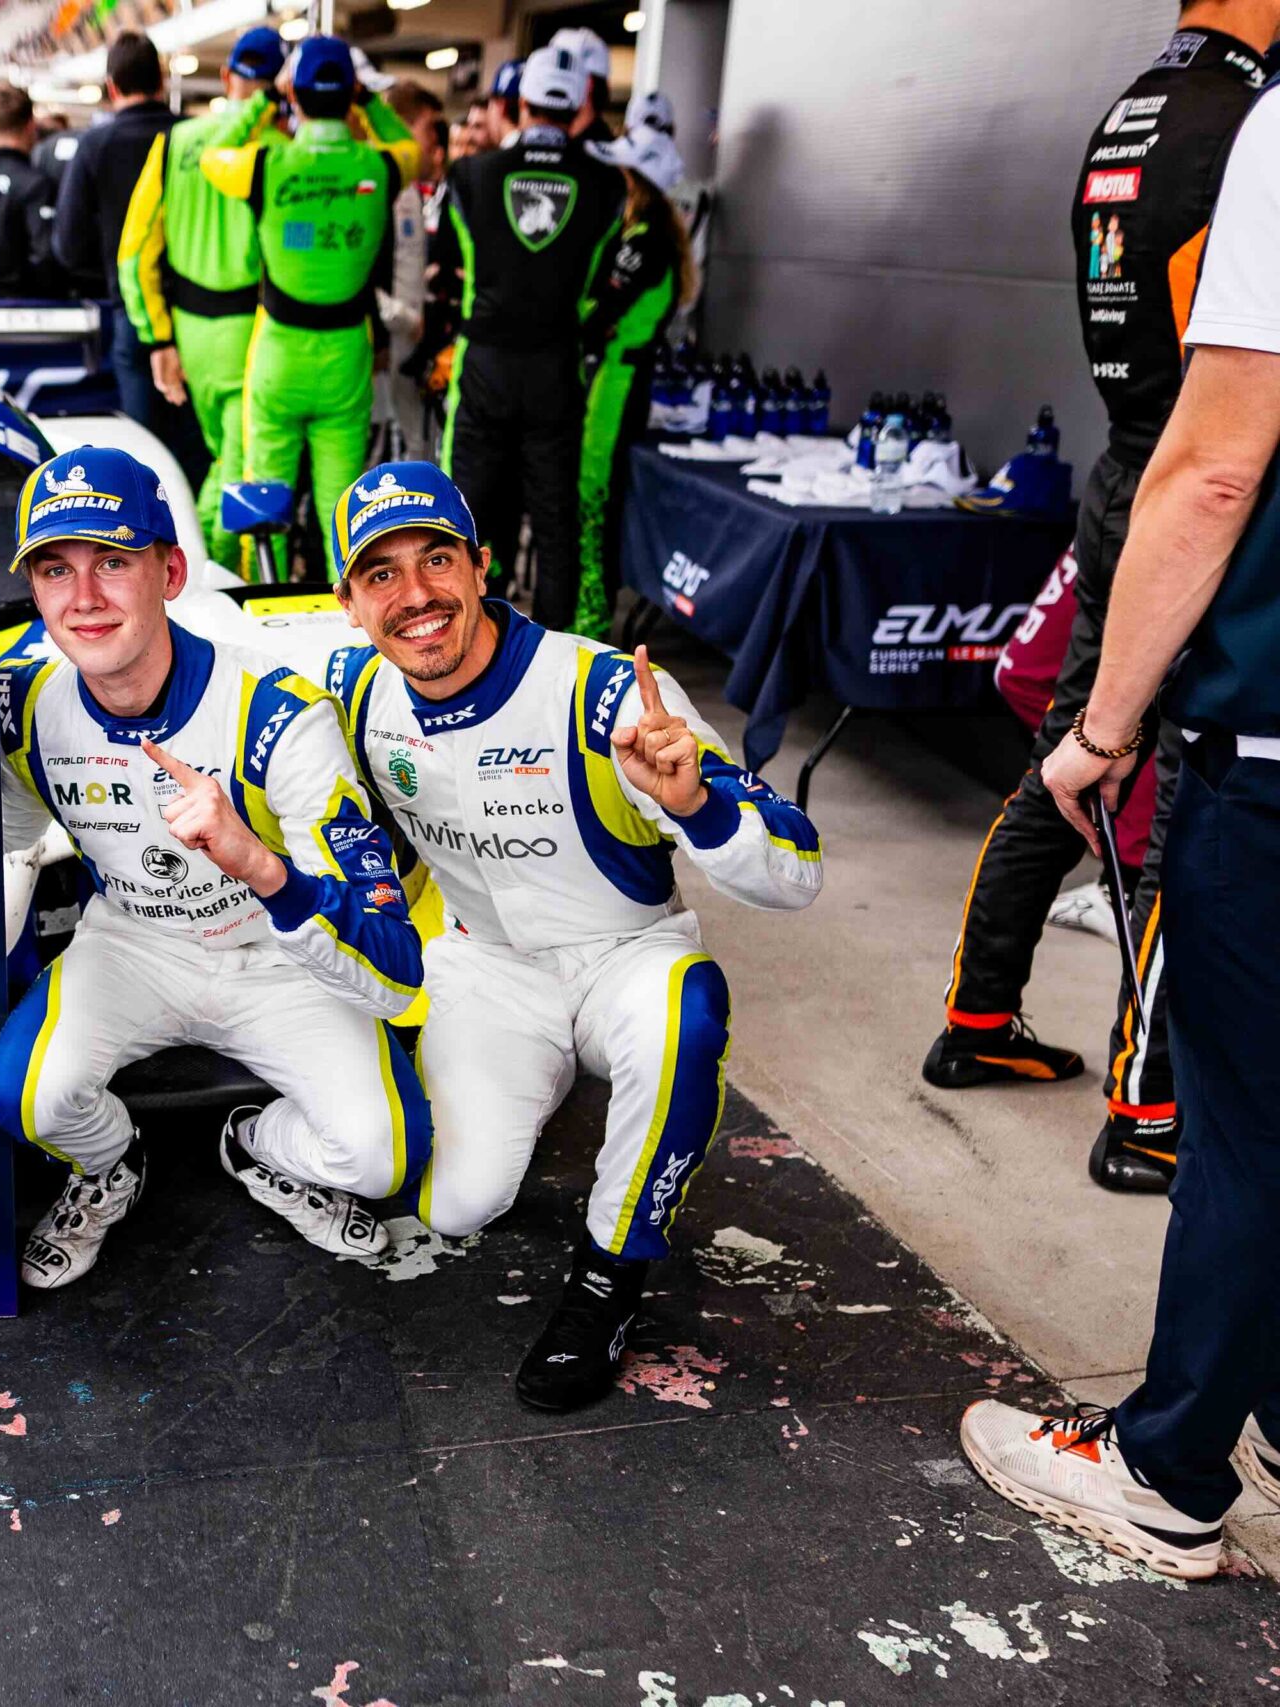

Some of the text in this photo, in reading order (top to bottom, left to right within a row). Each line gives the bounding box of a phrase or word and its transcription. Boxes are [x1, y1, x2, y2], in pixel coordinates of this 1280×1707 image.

[1087, 172, 1136, 198] MOTUL
[30, 496, 121, 525] MICHELIN
[350, 495, 435, 537] MICHELIN
[871, 603, 1033, 646] ELMS
[869, 661, 920, 675] SERIES
[870, 648, 945, 663] EUROPEAN
[591, 664, 632, 737] HRX
[424, 703, 477, 728] HRX
[250, 701, 295, 773] HRX
[389, 749, 411, 759] SCP
[478, 748, 555, 767] ELMS
[478, 768, 513, 776] EUROPEAN
[478, 774, 503, 782] SERIES
[68, 820, 141, 833] SYNERGY
[104, 873, 136, 893] ATN
[141, 881, 214, 900] Service
[186, 900, 230, 922] LASER
[649, 1151, 695, 1226] HRX
